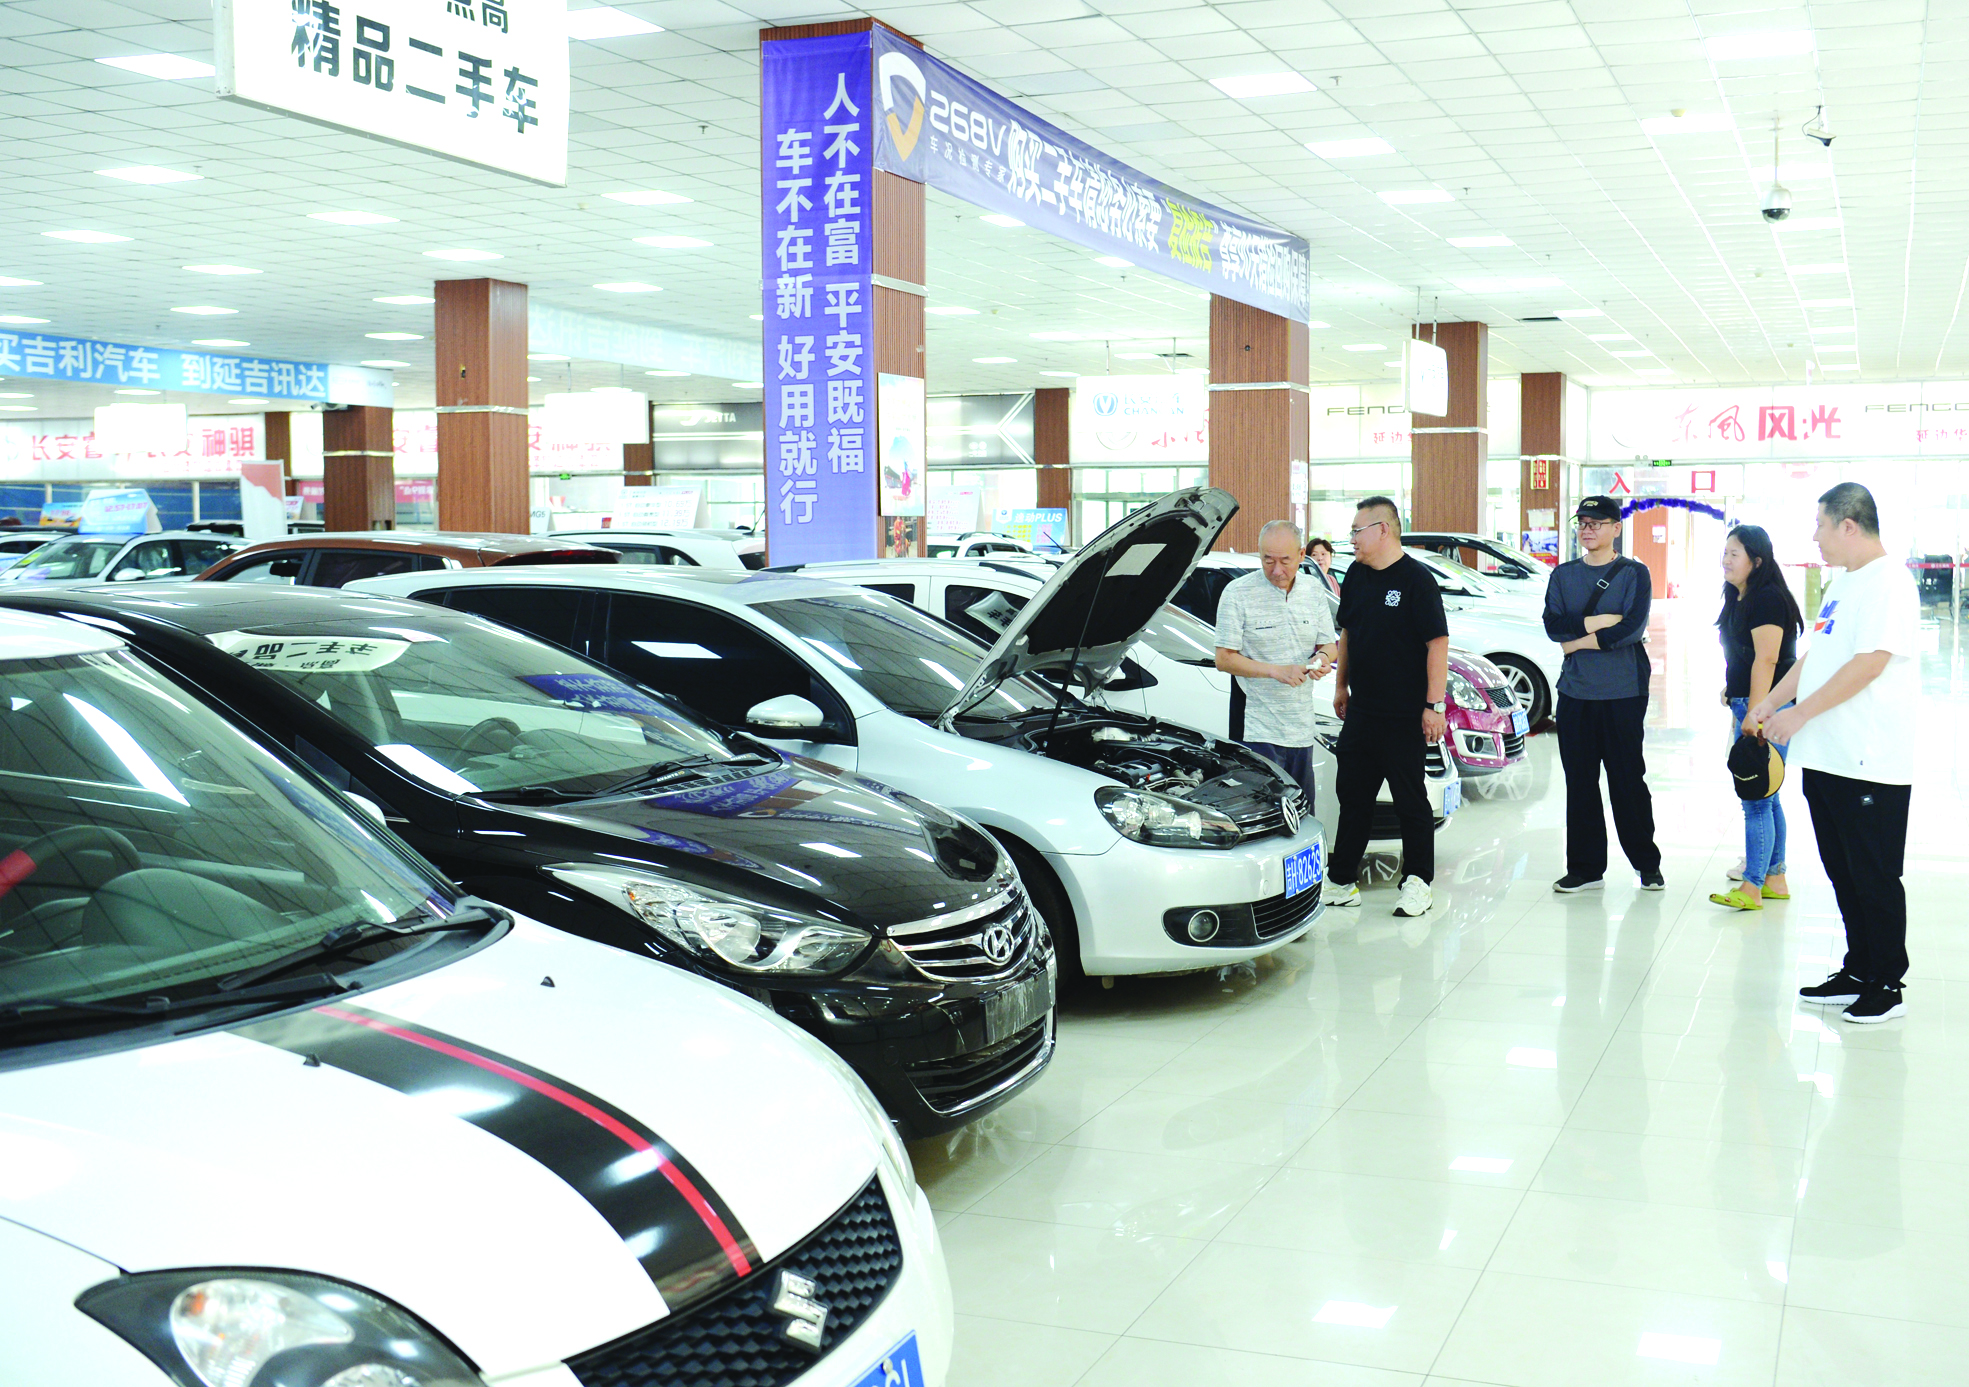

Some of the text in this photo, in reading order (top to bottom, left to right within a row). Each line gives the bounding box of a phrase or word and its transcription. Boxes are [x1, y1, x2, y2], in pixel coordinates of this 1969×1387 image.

[291, 0, 538, 134] 精品二手车
[930, 90, 1006, 156] 268V
[823, 72, 865, 474] 人不在富 平安既福
[776, 128, 818, 525] 车不在新 好用就行
[181, 354, 326, 397] 到延吉讯达
[1124, 407, 1184, 416] CHANAN
[1609, 471, 1716, 494] 入口
